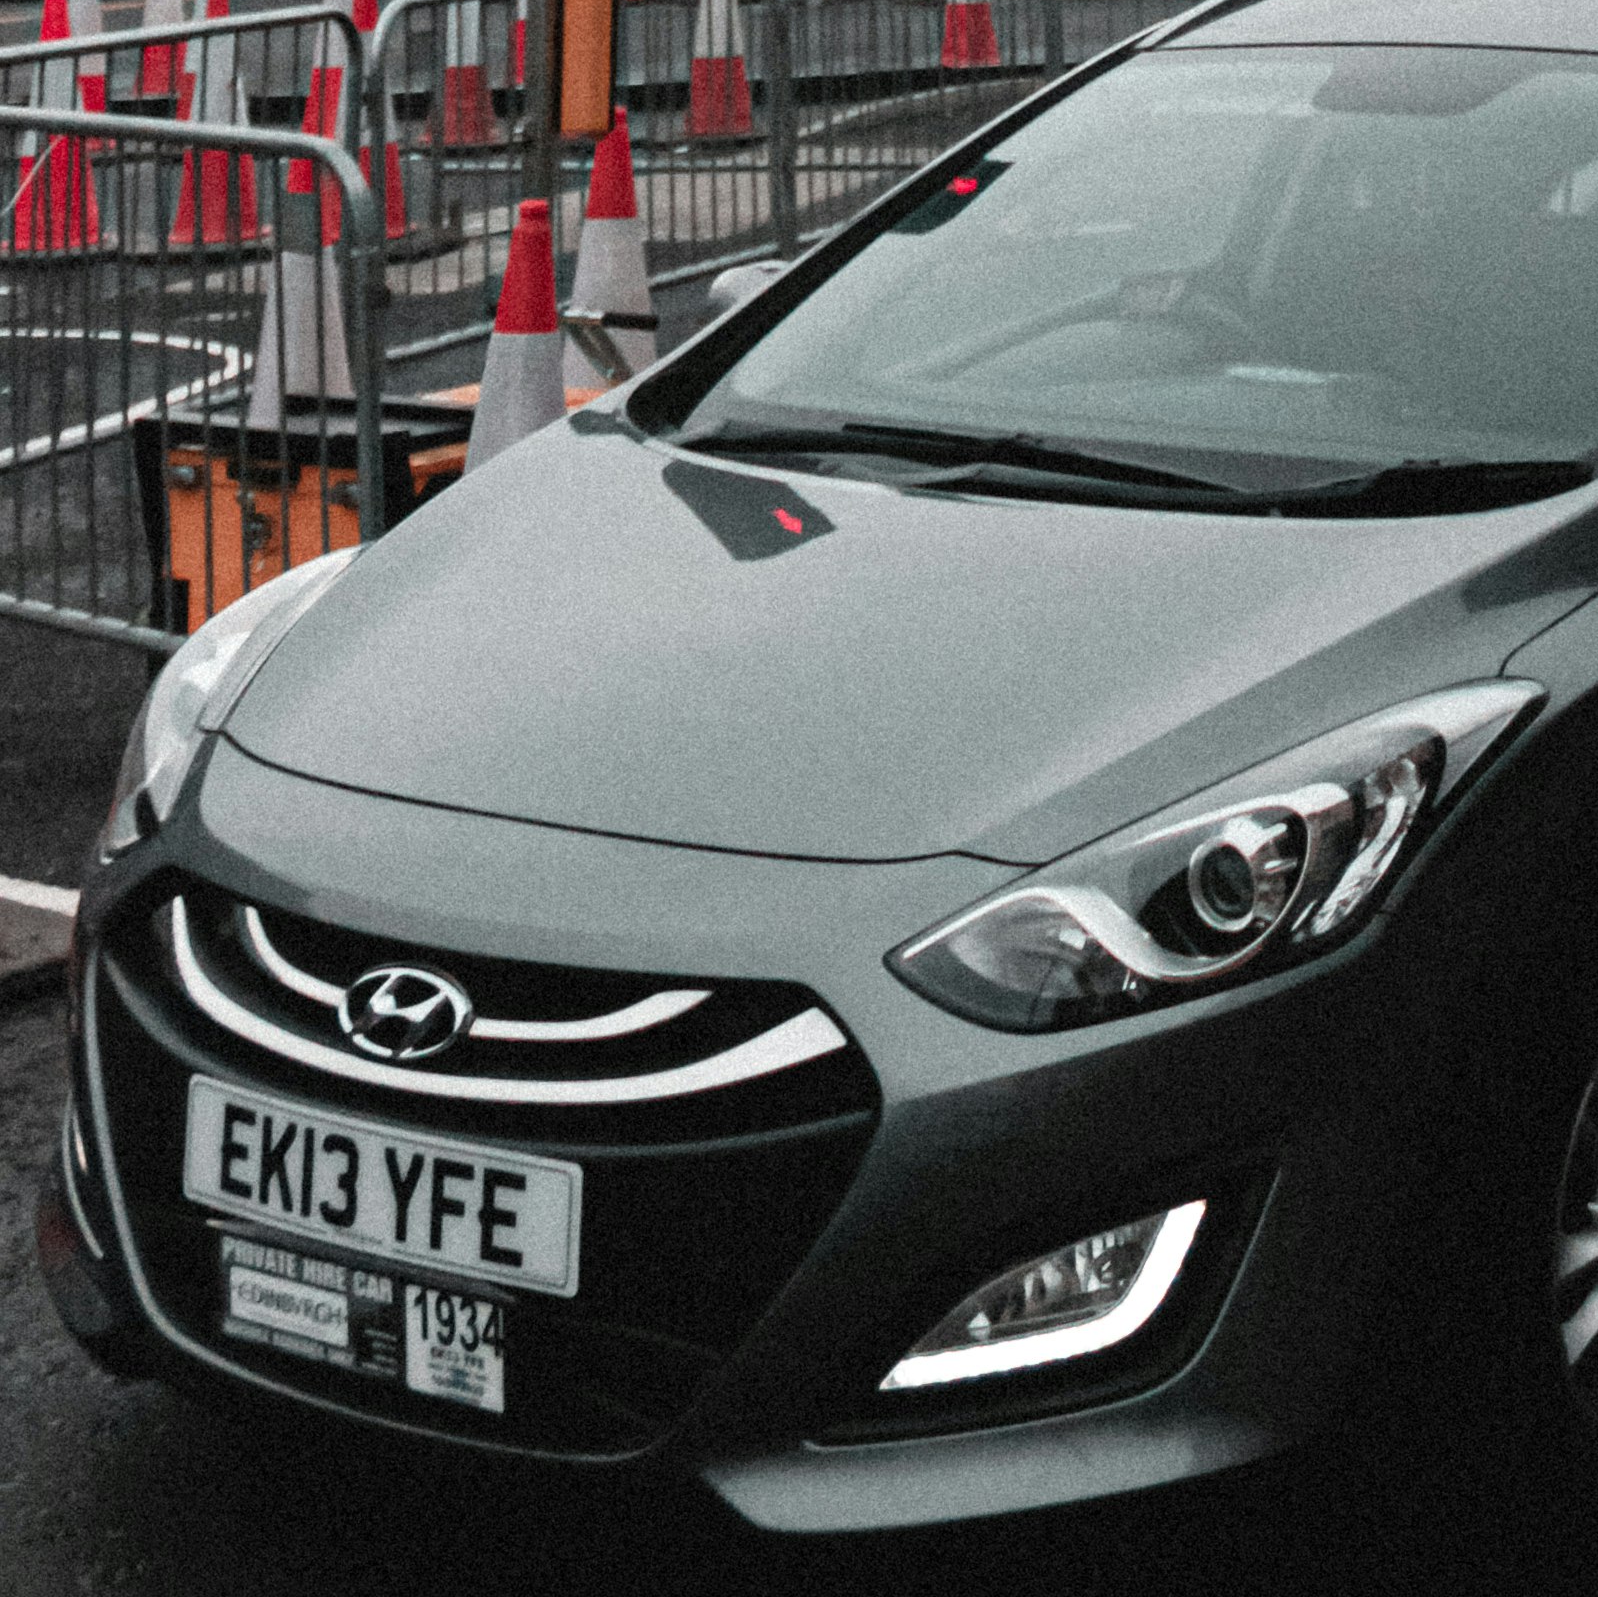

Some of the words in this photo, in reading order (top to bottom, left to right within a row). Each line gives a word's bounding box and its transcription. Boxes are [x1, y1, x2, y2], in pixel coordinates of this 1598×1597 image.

[220, 1102, 360, 1229] EK13
[384, 1146, 527, 1268] YFE
[221, 1235, 297, 1279] PRIVATE
[302, 1257, 348, 1292] HIRE
[352, 1270, 394, 1305] CAR
[414, 1286, 504, 1360] 1934
